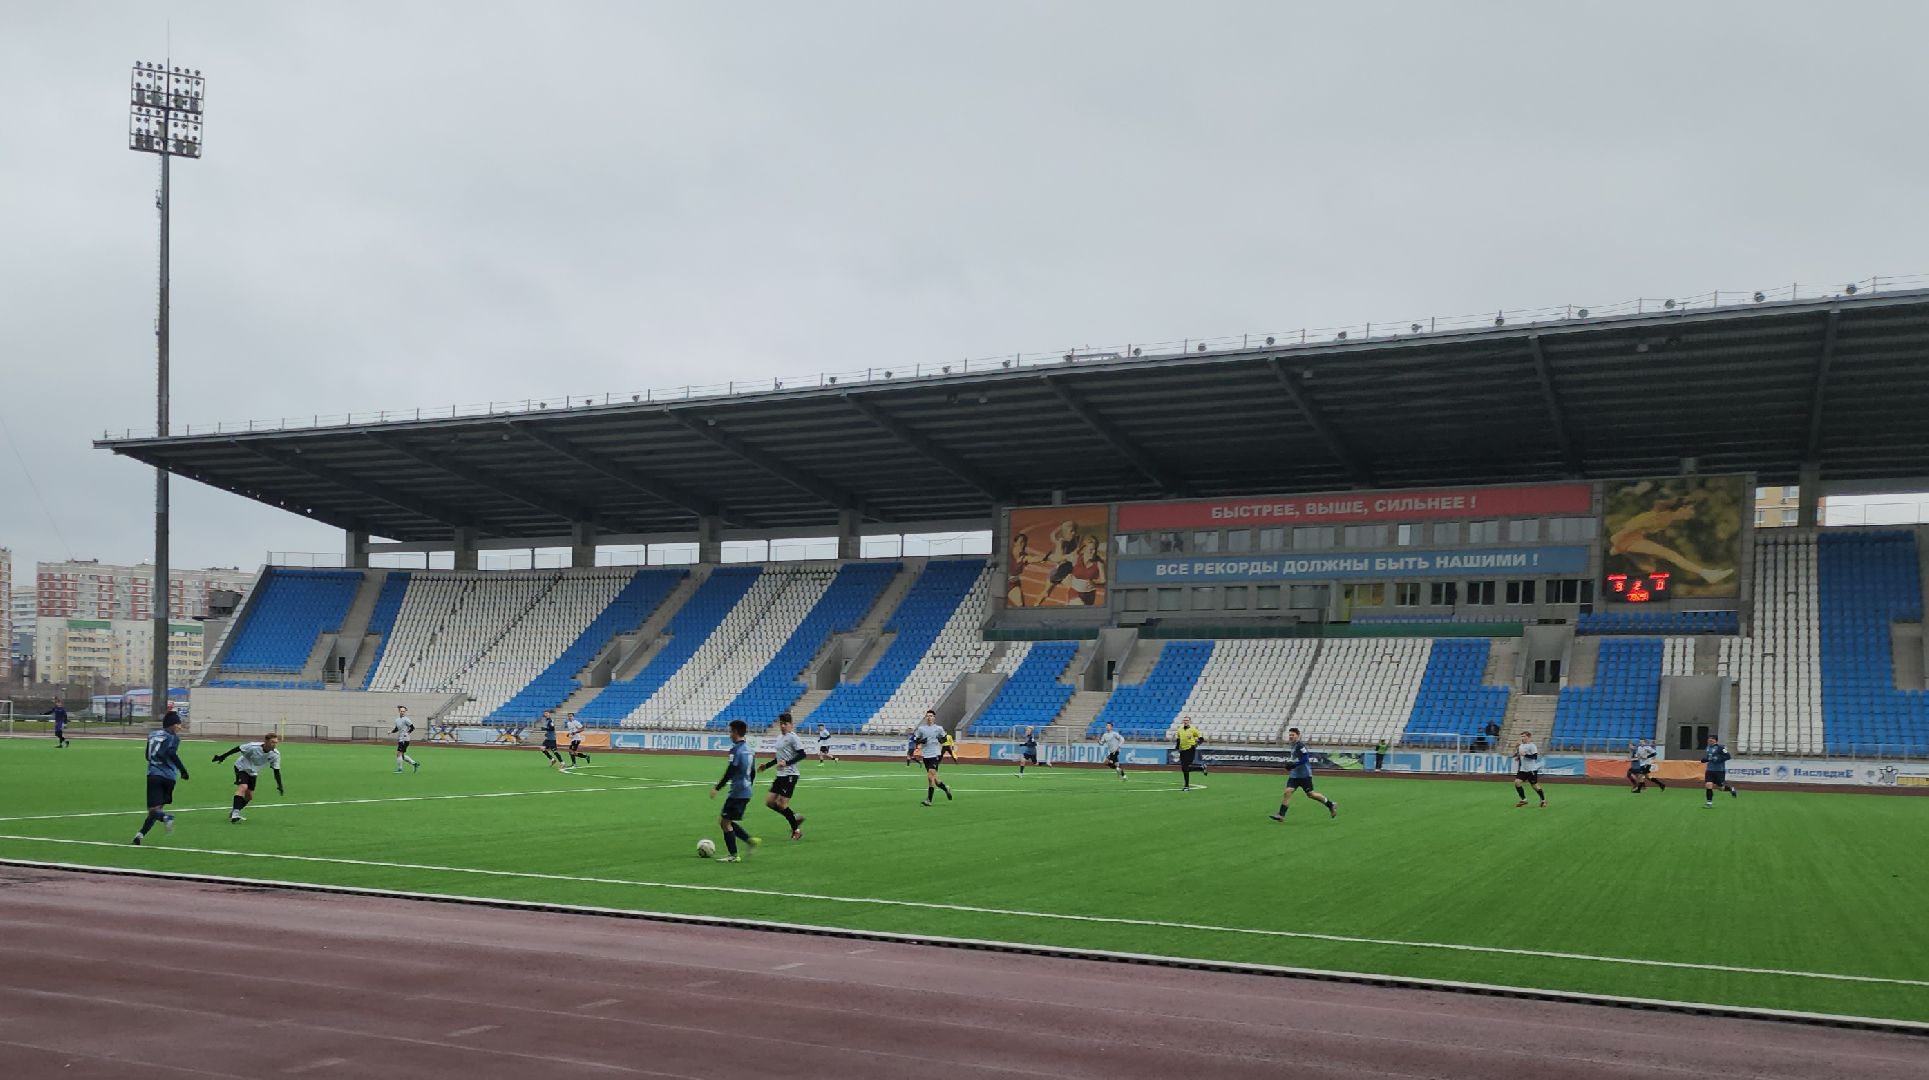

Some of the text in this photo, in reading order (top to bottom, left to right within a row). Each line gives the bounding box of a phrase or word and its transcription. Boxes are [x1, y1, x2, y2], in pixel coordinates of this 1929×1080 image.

[1211, 504, 1300, 519] БЫСТРЕЕ,
[1306, 501, 1368, 515] ВЫШЕ,
[1374, 496, 1465, 512] СИЛЬНЕЕ
[1155, 563, 1189, 576] ВСЕ
[1193, 560, 1278, 576] РЕКОРДЫ
[1282, 558, 1369, 575] ДОЛЖНЫ
[1374, 557, 1430, 571] БЫТЬ
[1435, 553, 1527, 569] НАШИМИ
[652, 734, 701, 750] ГАЗПРОМ
